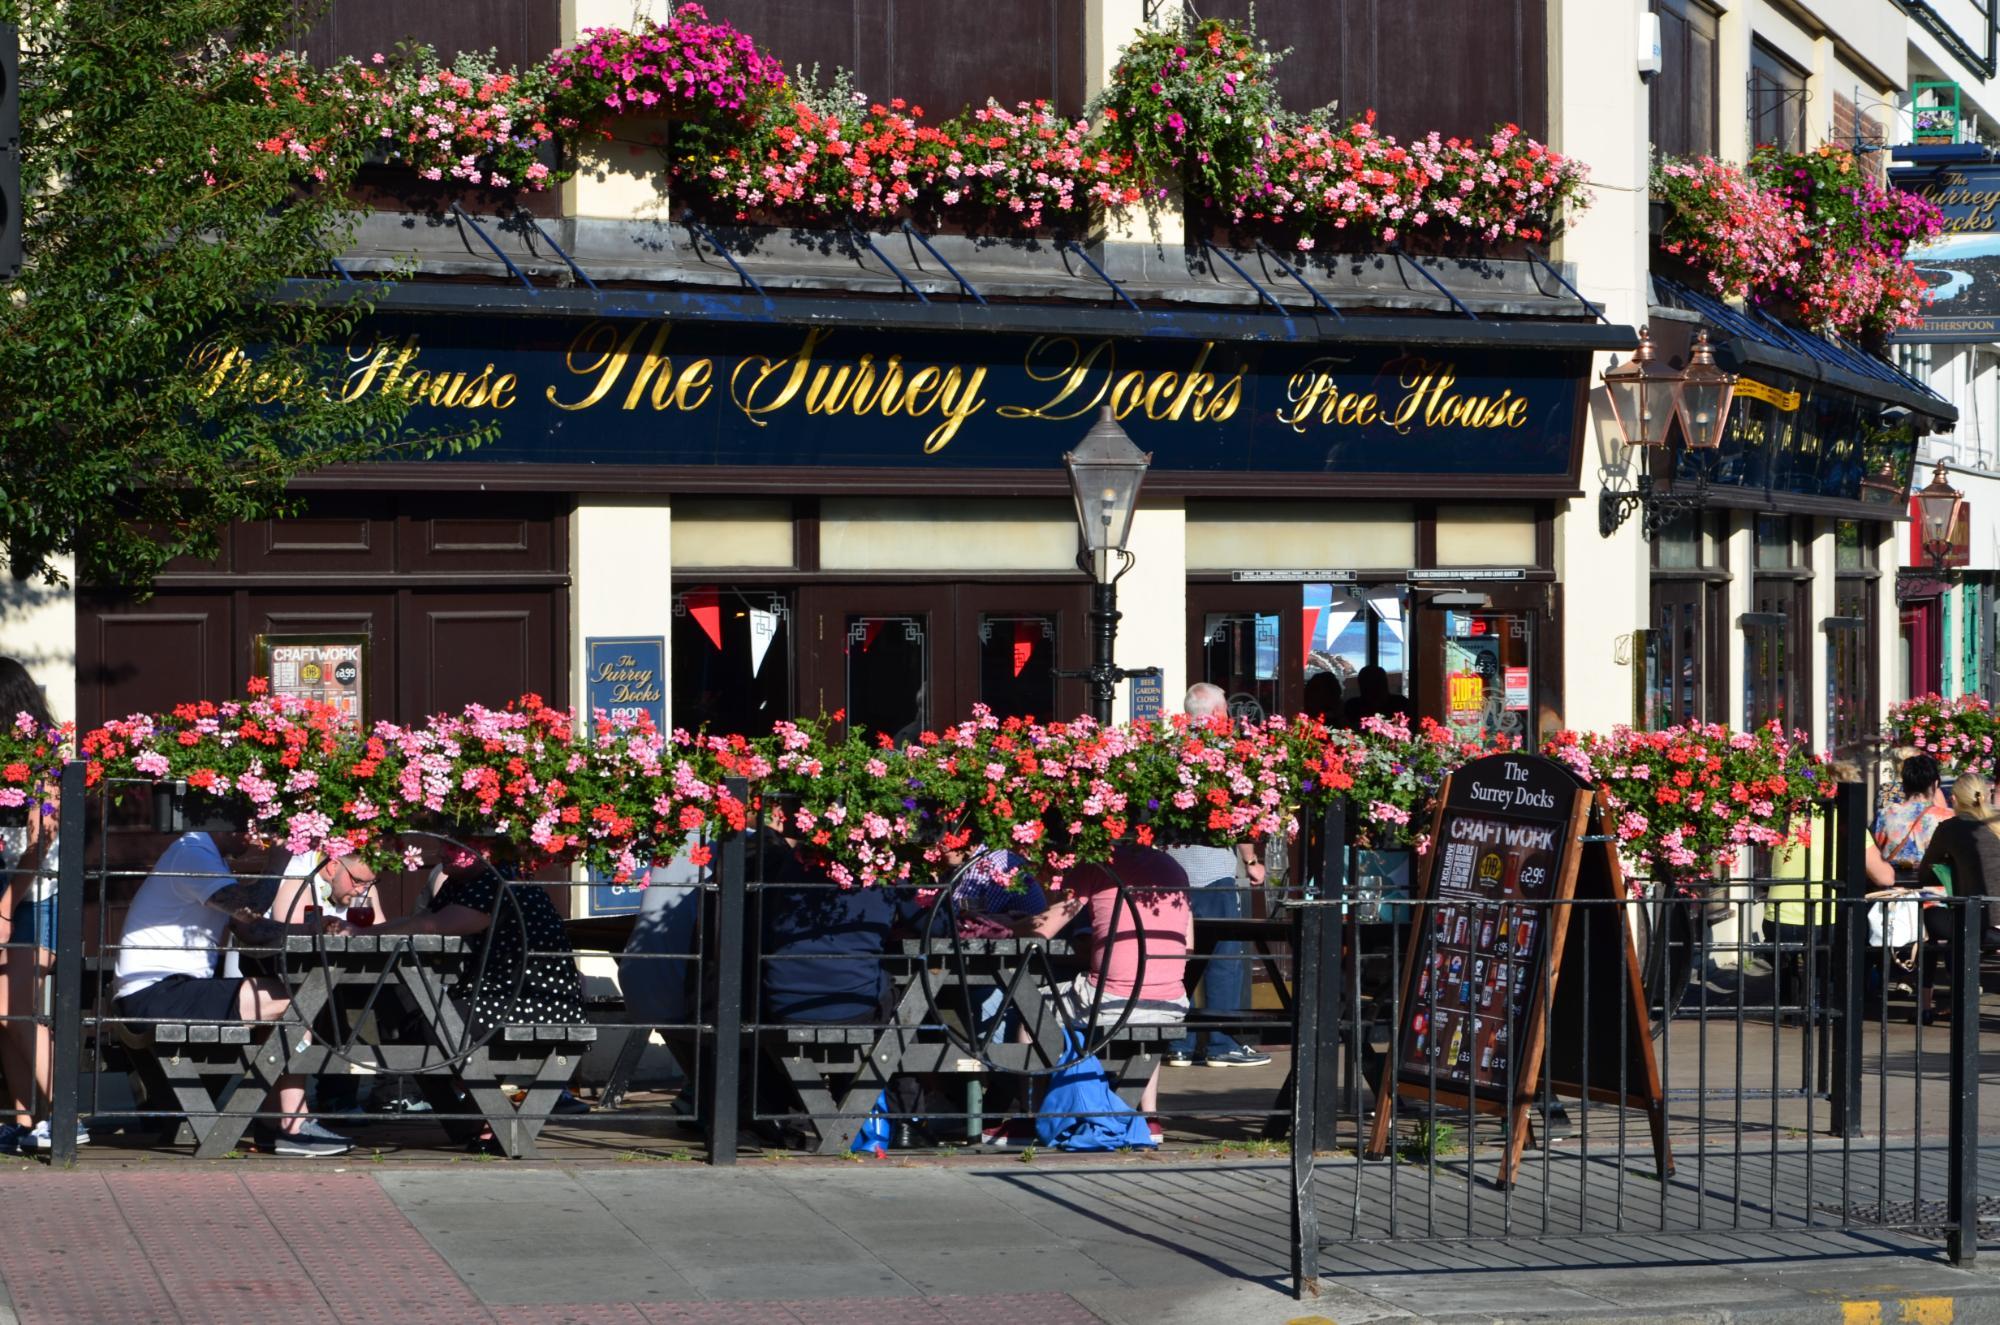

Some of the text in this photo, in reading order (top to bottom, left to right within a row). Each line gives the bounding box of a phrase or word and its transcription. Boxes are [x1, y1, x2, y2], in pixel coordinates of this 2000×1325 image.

[1938, 172, 1968, 185] The
[1942, 206, 1995, 230] ocks
[322, 330, 517, 409] House
[546, 319, 1248, 455] The Surrey Docks
[1276, 356, 1528, 434] Free House
[273, 648, 358, 661] CRAFTWORK
[616, 655, 637, 667] The
[591, 662, 653, 688] Surrey
[609, 683, 661, 703] Docks
[1504, 761, 1529, 781] The
[1470, 781, 1555, 810] Surrey Docks
